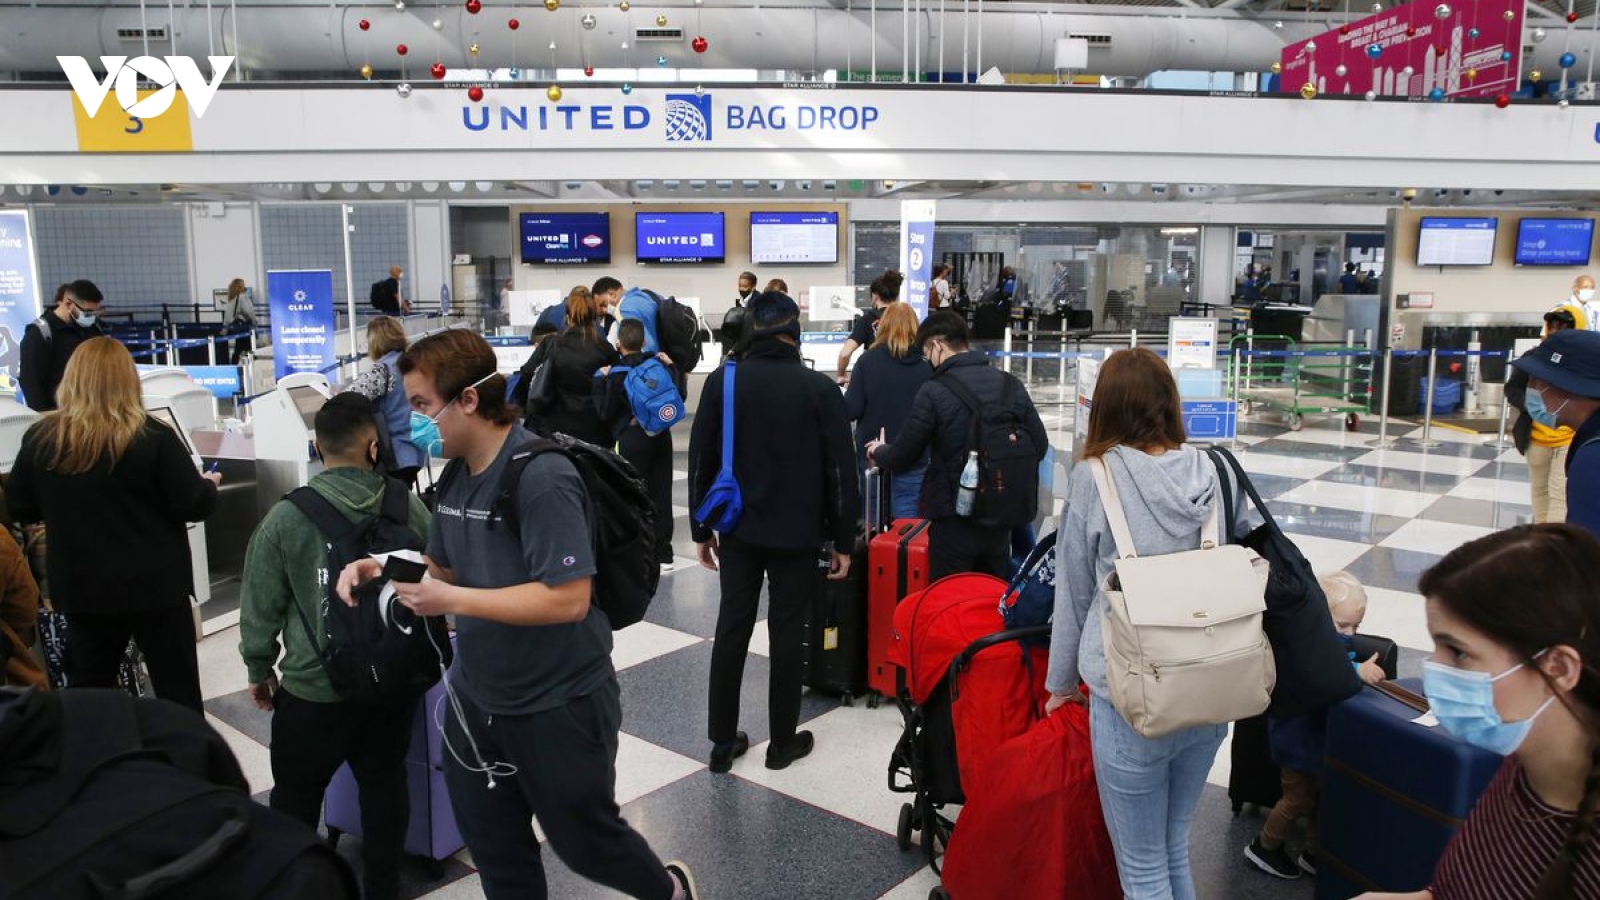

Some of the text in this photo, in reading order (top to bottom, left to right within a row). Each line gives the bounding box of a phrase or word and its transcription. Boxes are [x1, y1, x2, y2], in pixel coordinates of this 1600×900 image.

[463, 105, 880, 131] UNITED BAG DROP
[647, 235, 699, 245] UNITED
[910, 232, 925, 245] Step
[281, 324, 325, 334] Lane closed
[281, 336, 326, 346] temporarily
